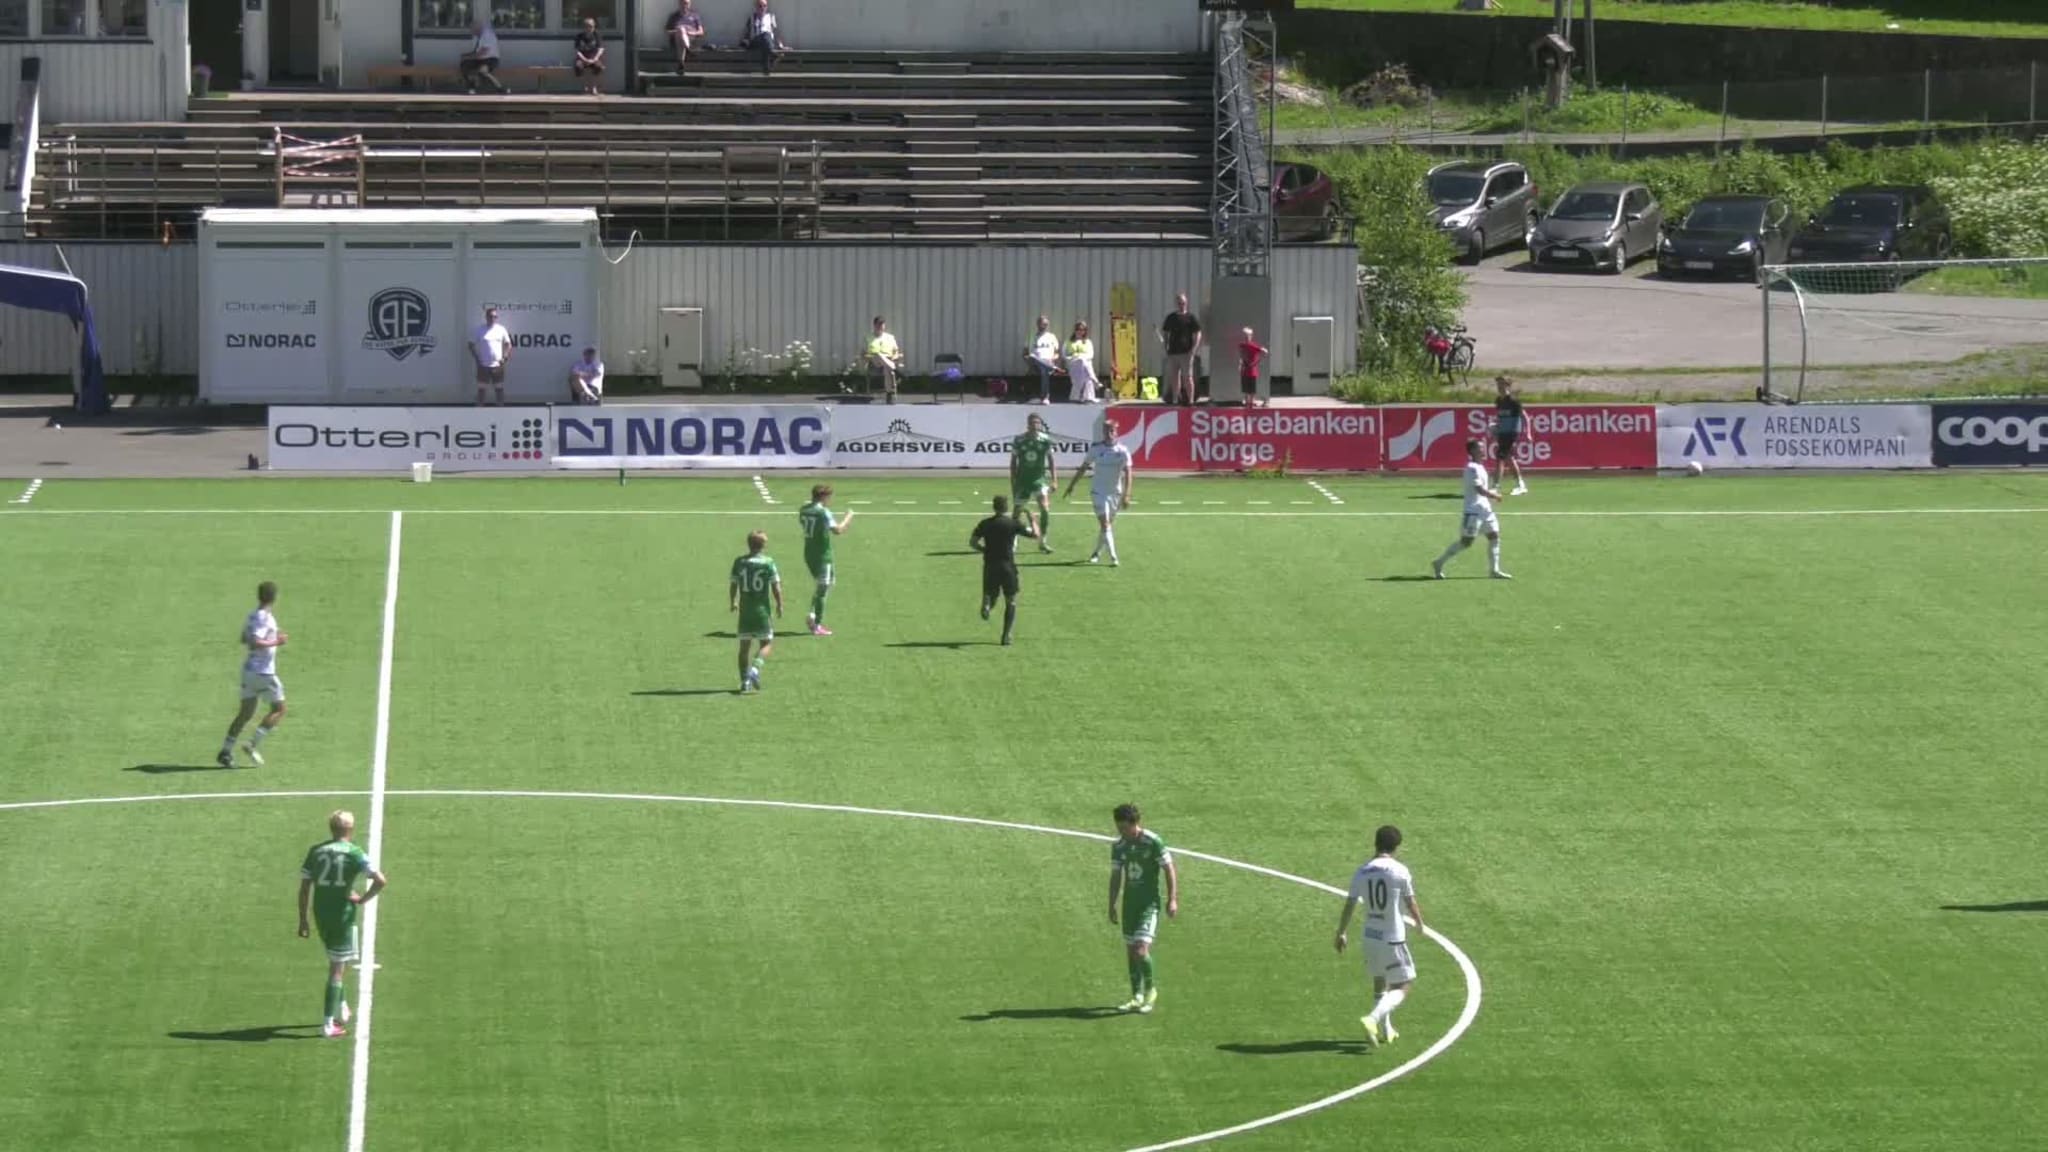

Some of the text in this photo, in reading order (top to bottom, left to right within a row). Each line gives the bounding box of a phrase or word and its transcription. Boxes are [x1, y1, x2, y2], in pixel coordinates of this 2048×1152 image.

[249, 333, 317, 348] NORAC
[275, 423, 497, 449] Otterlei
[626, 417, 823, 456] NORAC
[1191, 410, 1375, 439] Sparebanken
[1467, 409, 1650, 439] Srebanken
[1764, 416, 1861, 434] ARENDALS
[1938, 416, 2048, 453] coop
[426, 452, 497, 460] GROUP
[835, 441, 966, 453] AGDERSVEIS
[1190, 438, 1275, 466] Norge
[1765, 438, 1906, 457] FOSSEKOMPANI
[740, 567, 764, 592] 16
[317, 853, 346, 887] 21
[1367, 878, 1387, 911] 10
